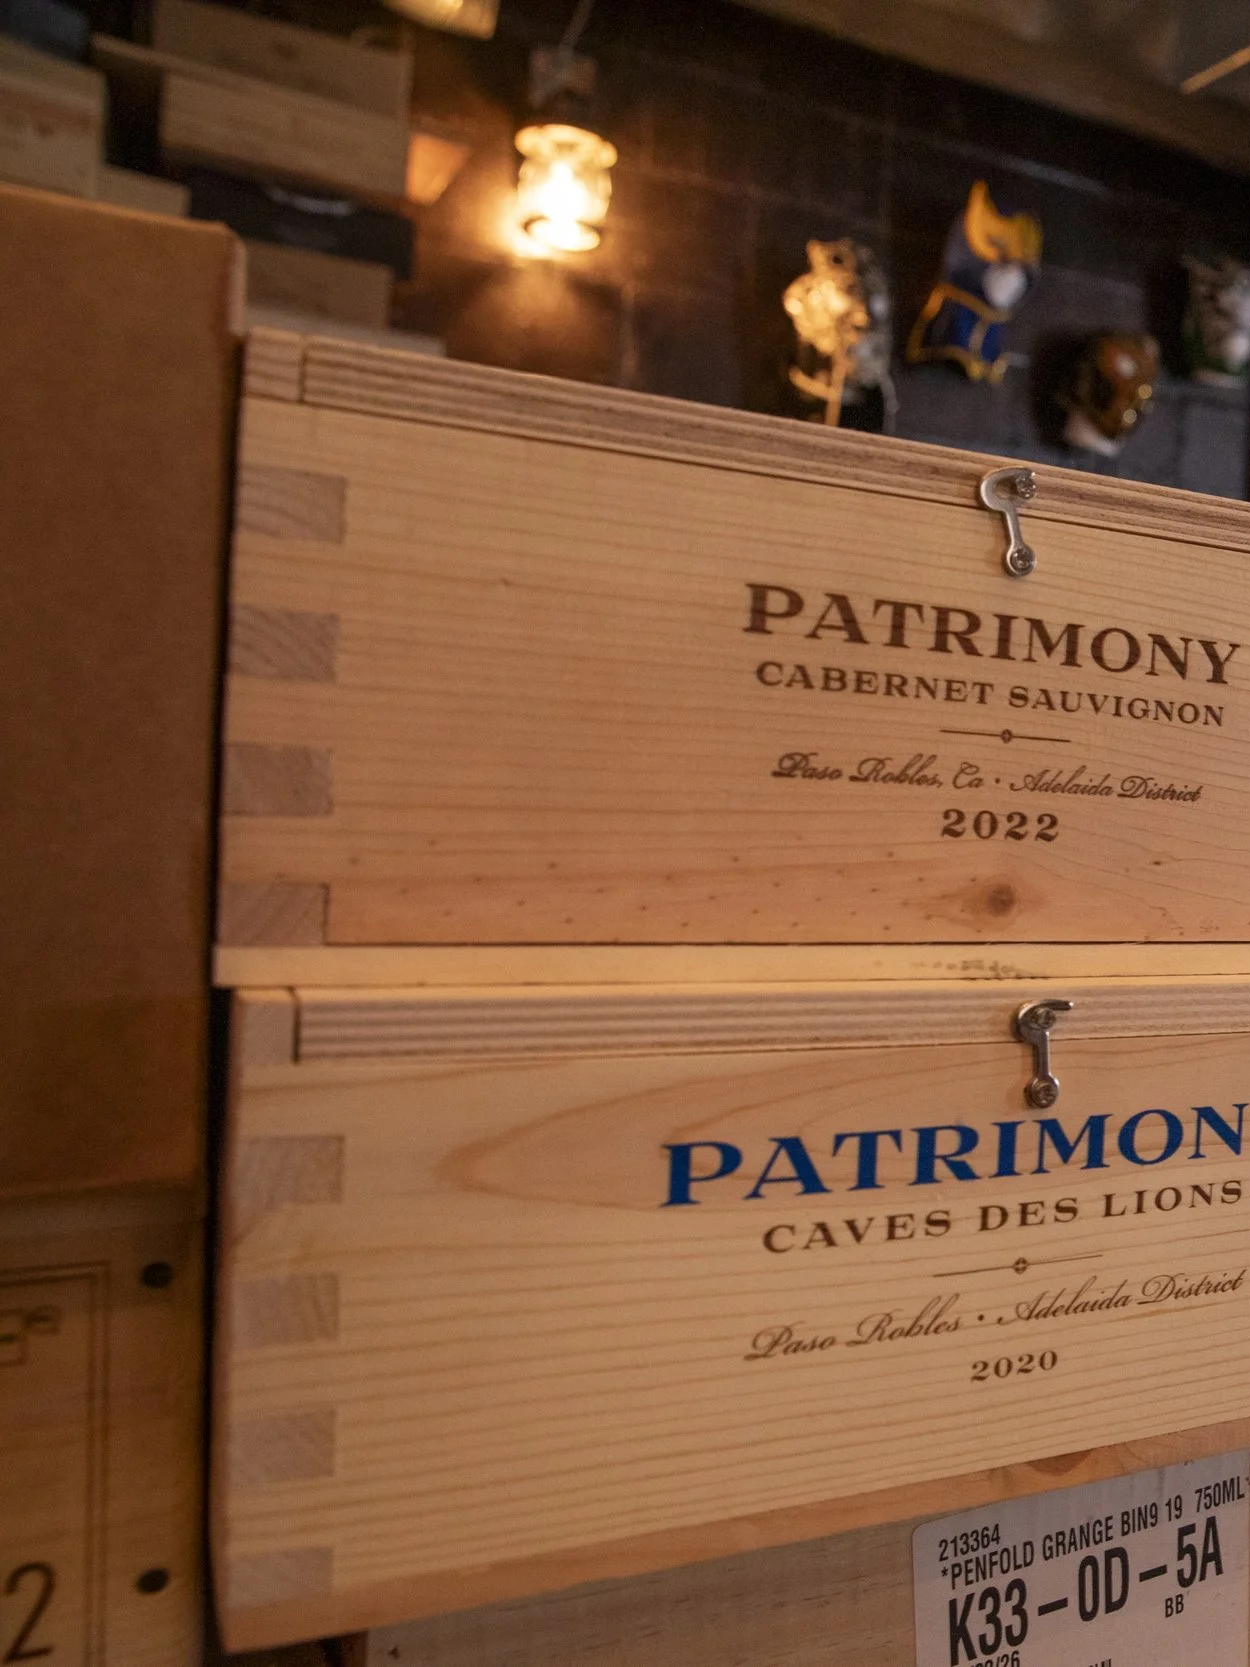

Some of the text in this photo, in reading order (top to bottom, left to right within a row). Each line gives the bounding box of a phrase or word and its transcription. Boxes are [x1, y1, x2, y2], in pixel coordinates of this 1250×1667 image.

[743, 583, 1240, 684] PATRIMONY
[755, 661, 1224, 727] CABERNET SAUVIGNON
[771, 752, 1203, 802] Paso Robles, Ca Adelaida District
[940, 808, 1059, 842] 2022
[763, 1179, 1242, 1255] CAVES DES LIONS
[743, 1268, 1248, 1361] Paso Robles Adelaida District
[970, 1350, 1058, 1382] 2020
[939, 1523, 1001, 1562] 213364
[1042, 1515, 1114, 1561] GRANGE
[1121, 1502, 1158, 1537] BIN9
[1165, 1494, 1183, 1522] 19
[1194, 1475, 1246, 1513] 750ML
[1165, 1593, 1184, 1618] BB
